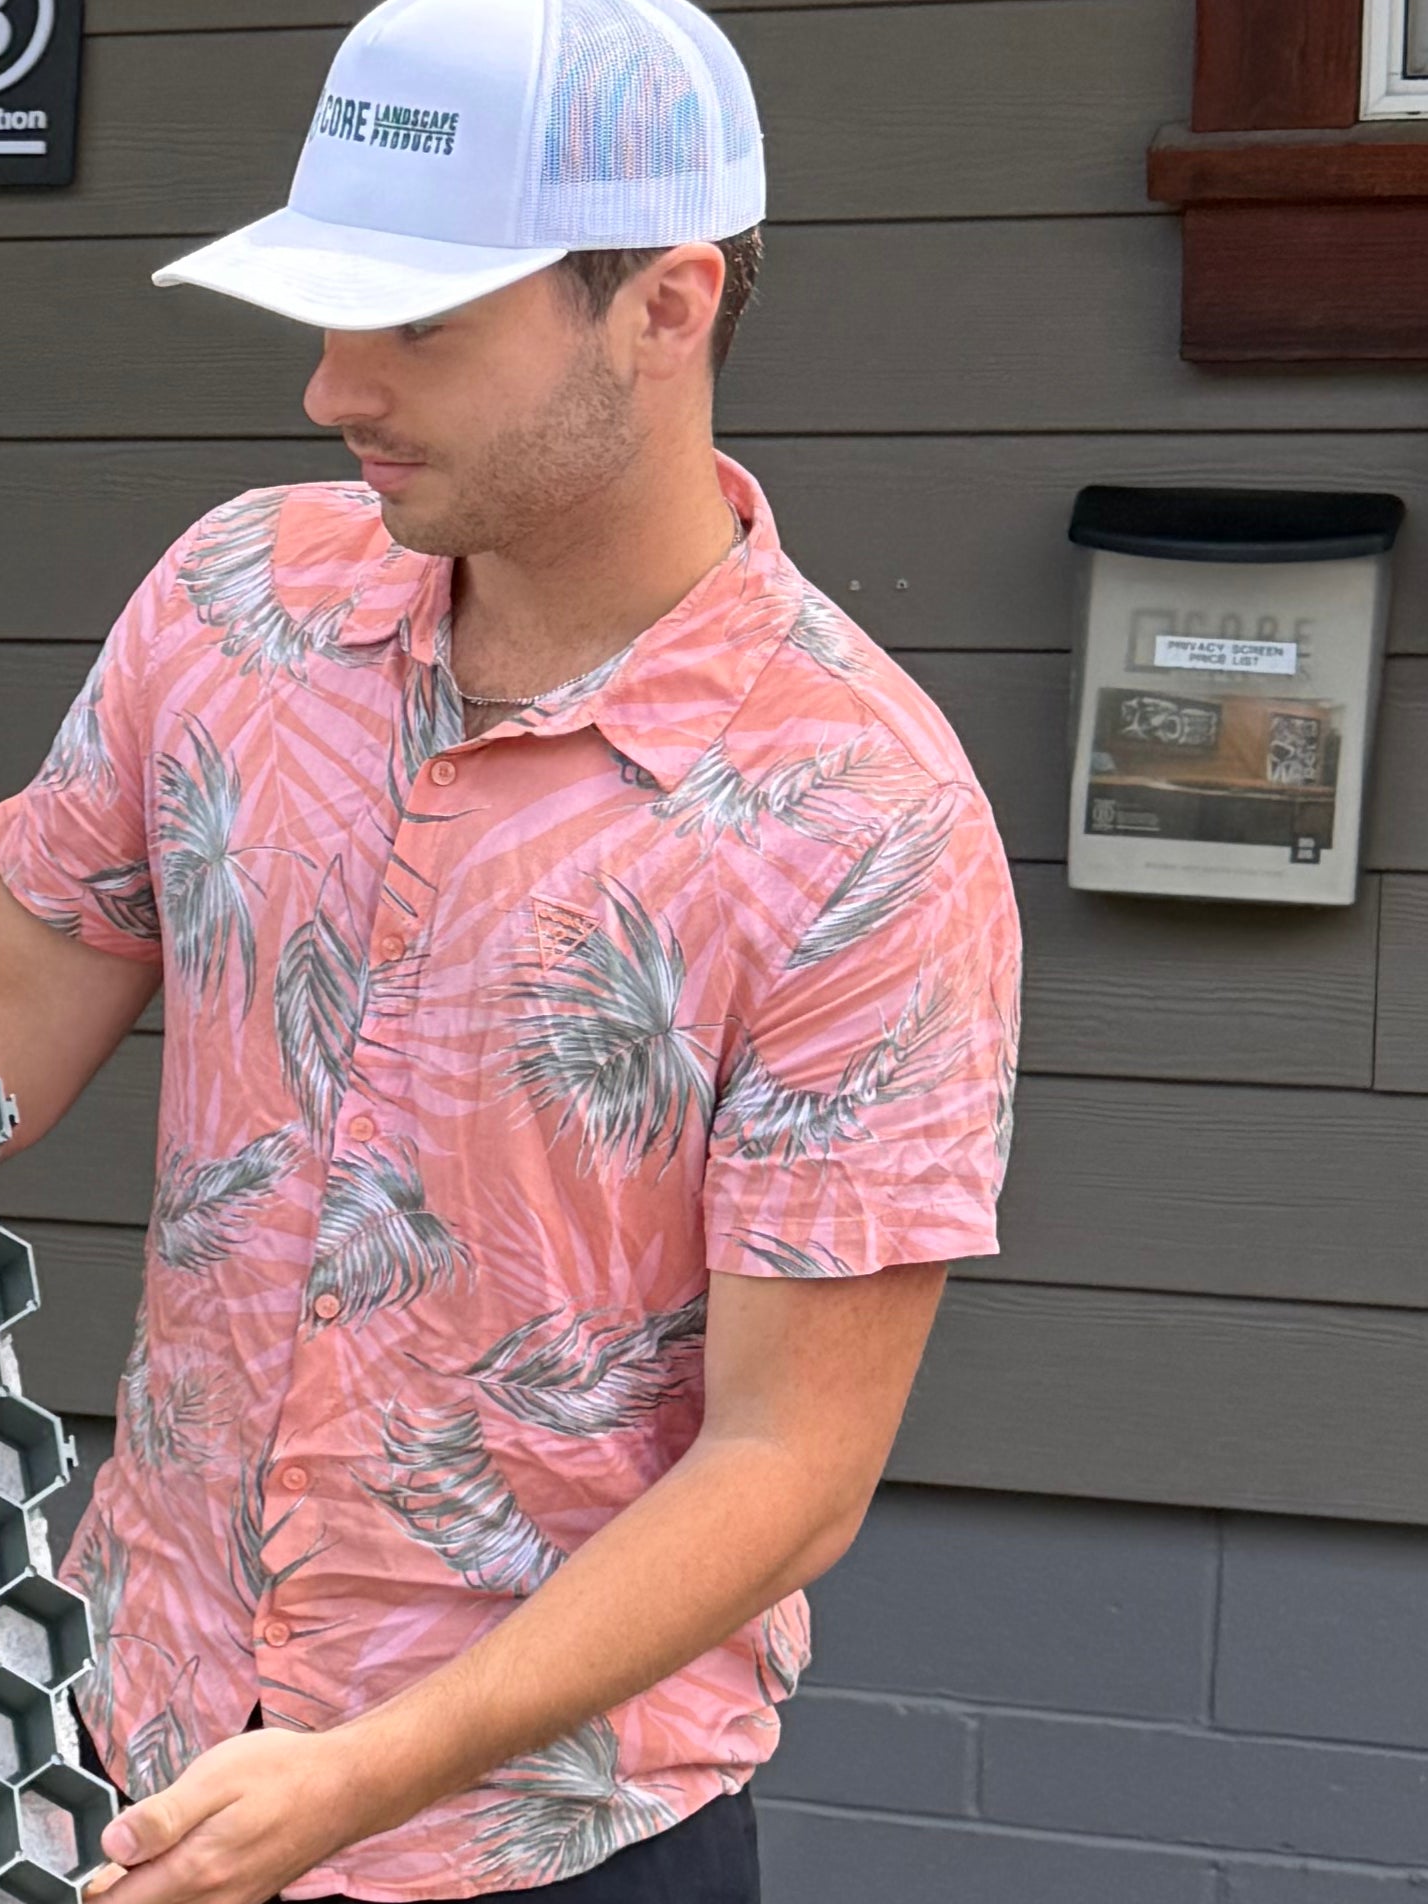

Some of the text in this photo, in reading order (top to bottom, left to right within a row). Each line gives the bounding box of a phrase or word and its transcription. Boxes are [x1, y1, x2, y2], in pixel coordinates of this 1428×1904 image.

[319, 94, 371, 142] CORE
[374, 103, 460, 131] LANDSCAPE
[369, 127, 455, 155] PRODUCTS
